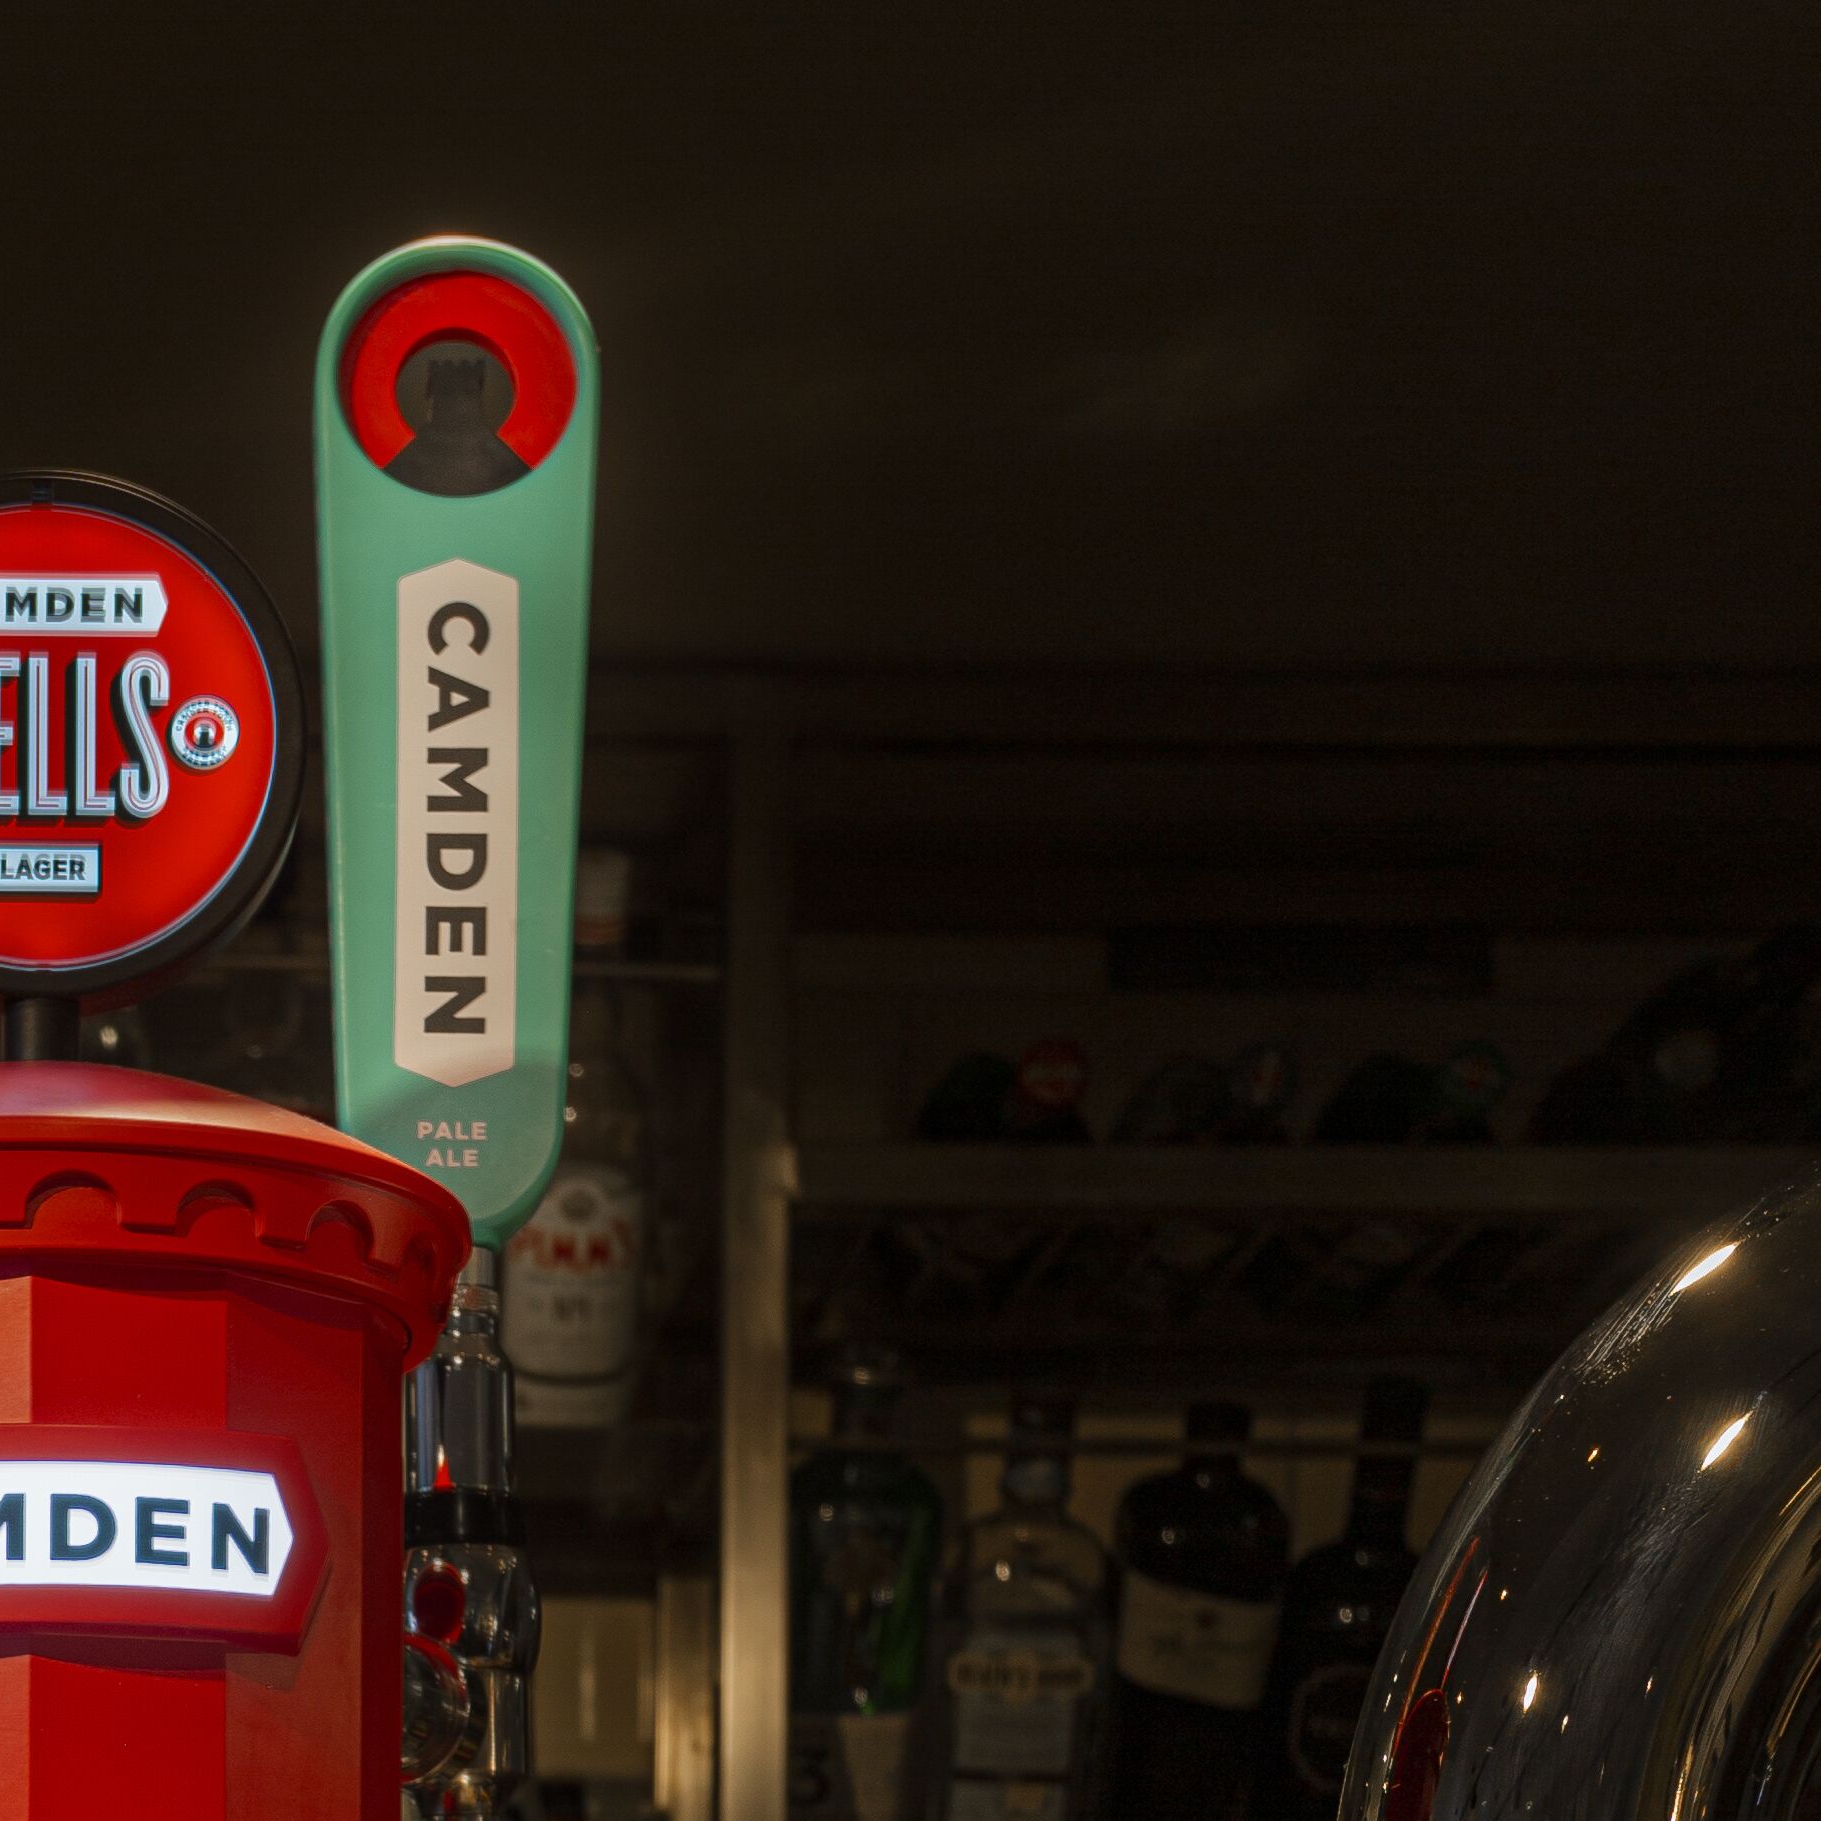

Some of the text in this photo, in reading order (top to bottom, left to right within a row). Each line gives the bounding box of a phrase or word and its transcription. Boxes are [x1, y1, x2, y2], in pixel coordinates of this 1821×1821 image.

[424, 600, 491, 1035] CAMDEN
[0, 853, 87, 881] LAGER
[416, 1120, 488, 1141] PALE
[425, 1148, 479, 1167] ALE
